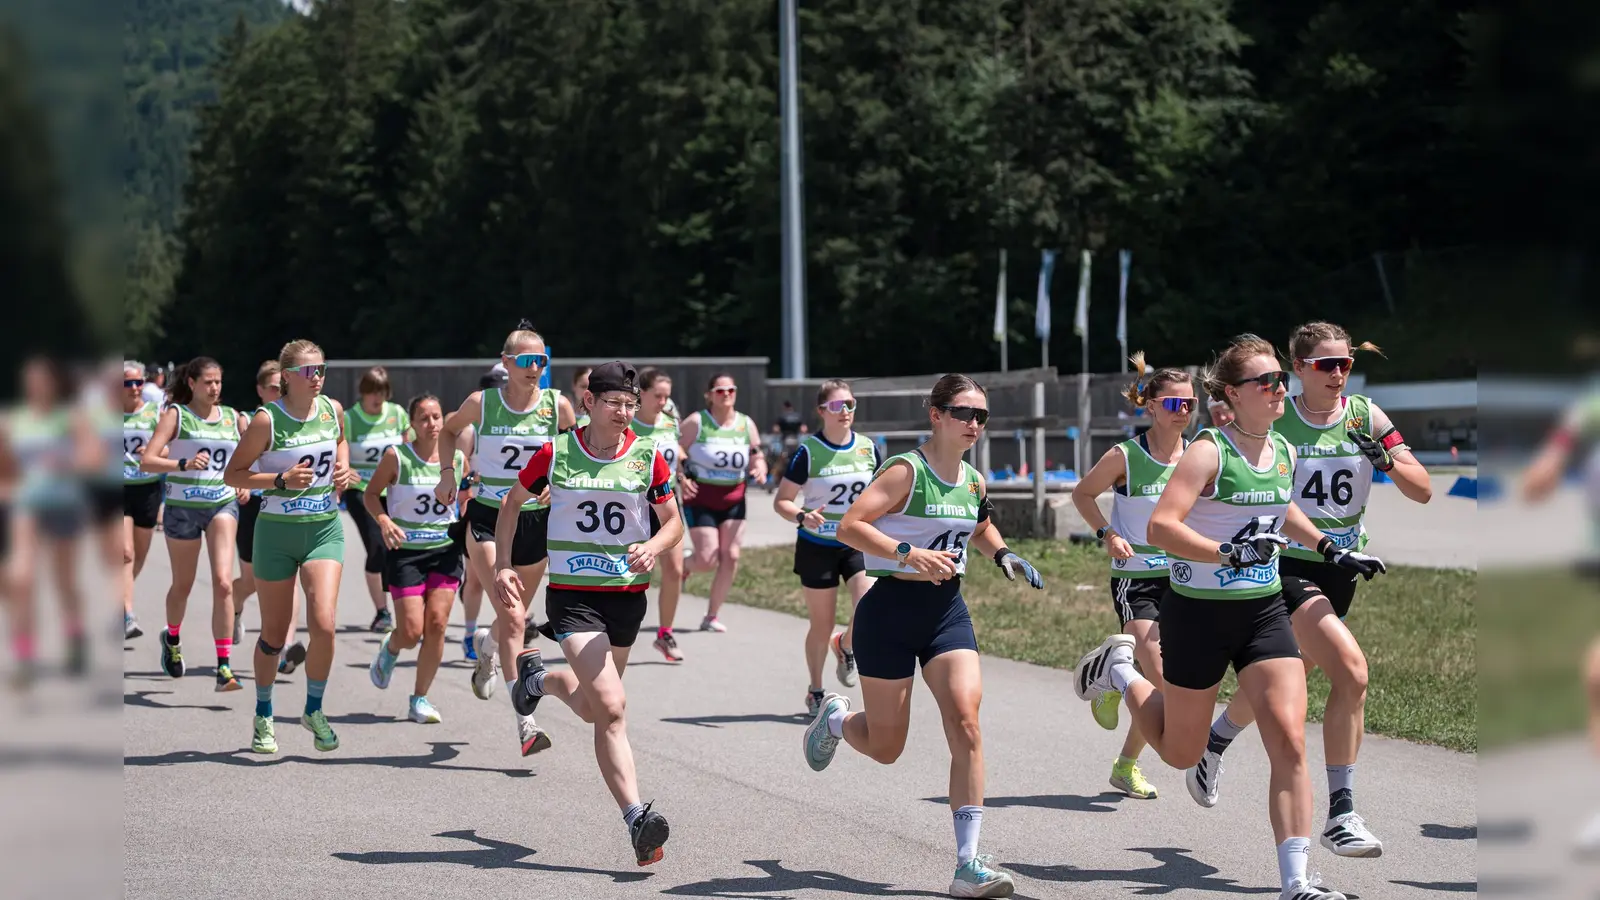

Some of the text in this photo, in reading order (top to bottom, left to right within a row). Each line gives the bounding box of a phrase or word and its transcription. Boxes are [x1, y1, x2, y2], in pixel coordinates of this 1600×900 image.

[1296, 443, 1337, 456] rima
[715, 451, 744, 469] 30
[564, 476, 615, 488] erima
[1301, 469, 1354, 506] 46
[828, 481, 866, 505] 28
[1231, 488, 1275, 503] erima
[925, 502, 967, 516] erima
[576, 500, 626, 536] 36
[1226, 567, 1276, 580] WALTHER
